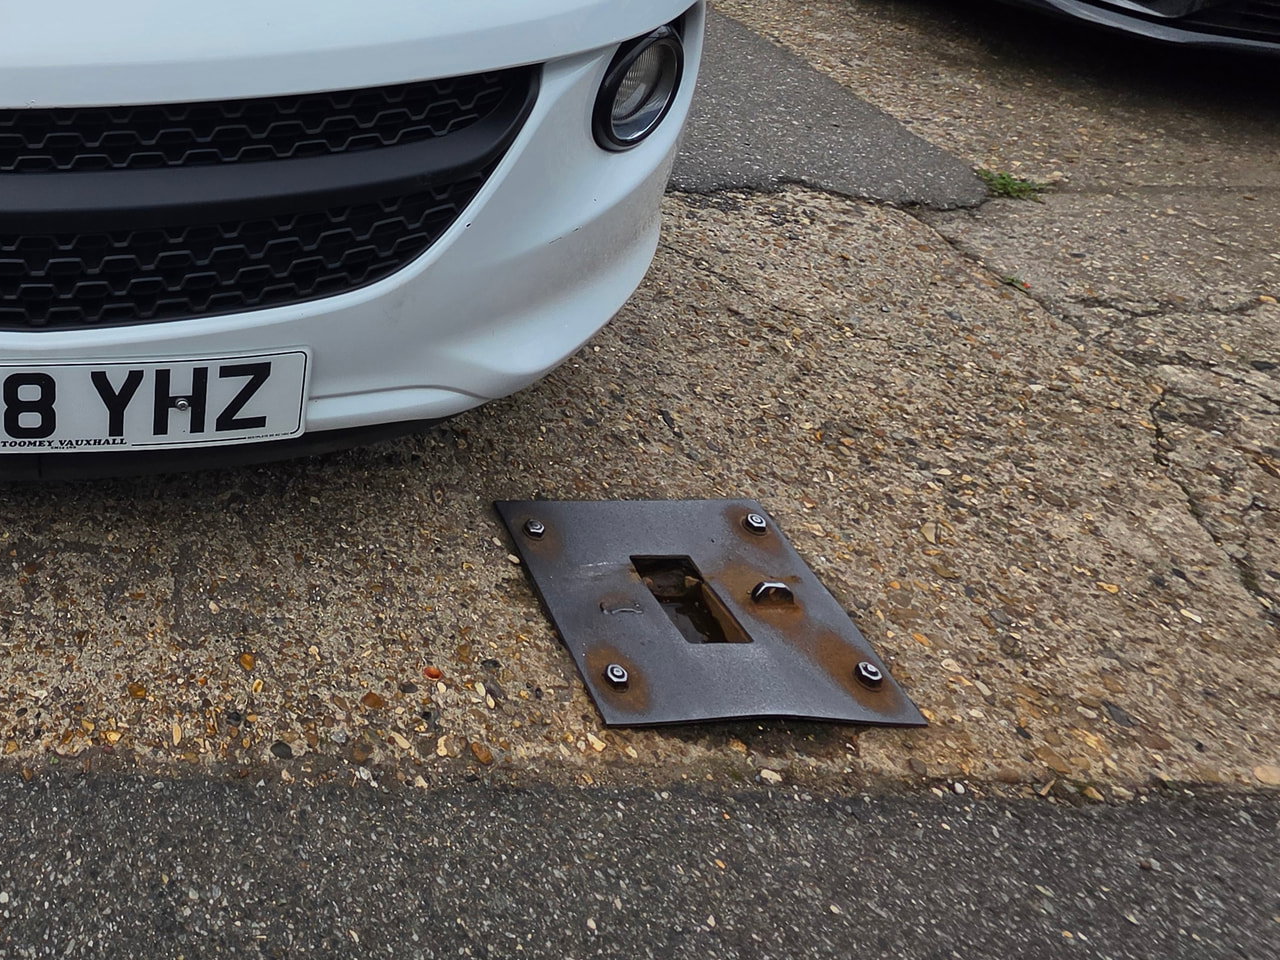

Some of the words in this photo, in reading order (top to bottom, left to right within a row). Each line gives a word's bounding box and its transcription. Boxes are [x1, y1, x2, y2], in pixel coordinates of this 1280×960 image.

[90, 361, 272, 437] YHZ
[0, 440, 55, 448] TOOMEY
[58, 438, 128, 447] VAUXHALL
